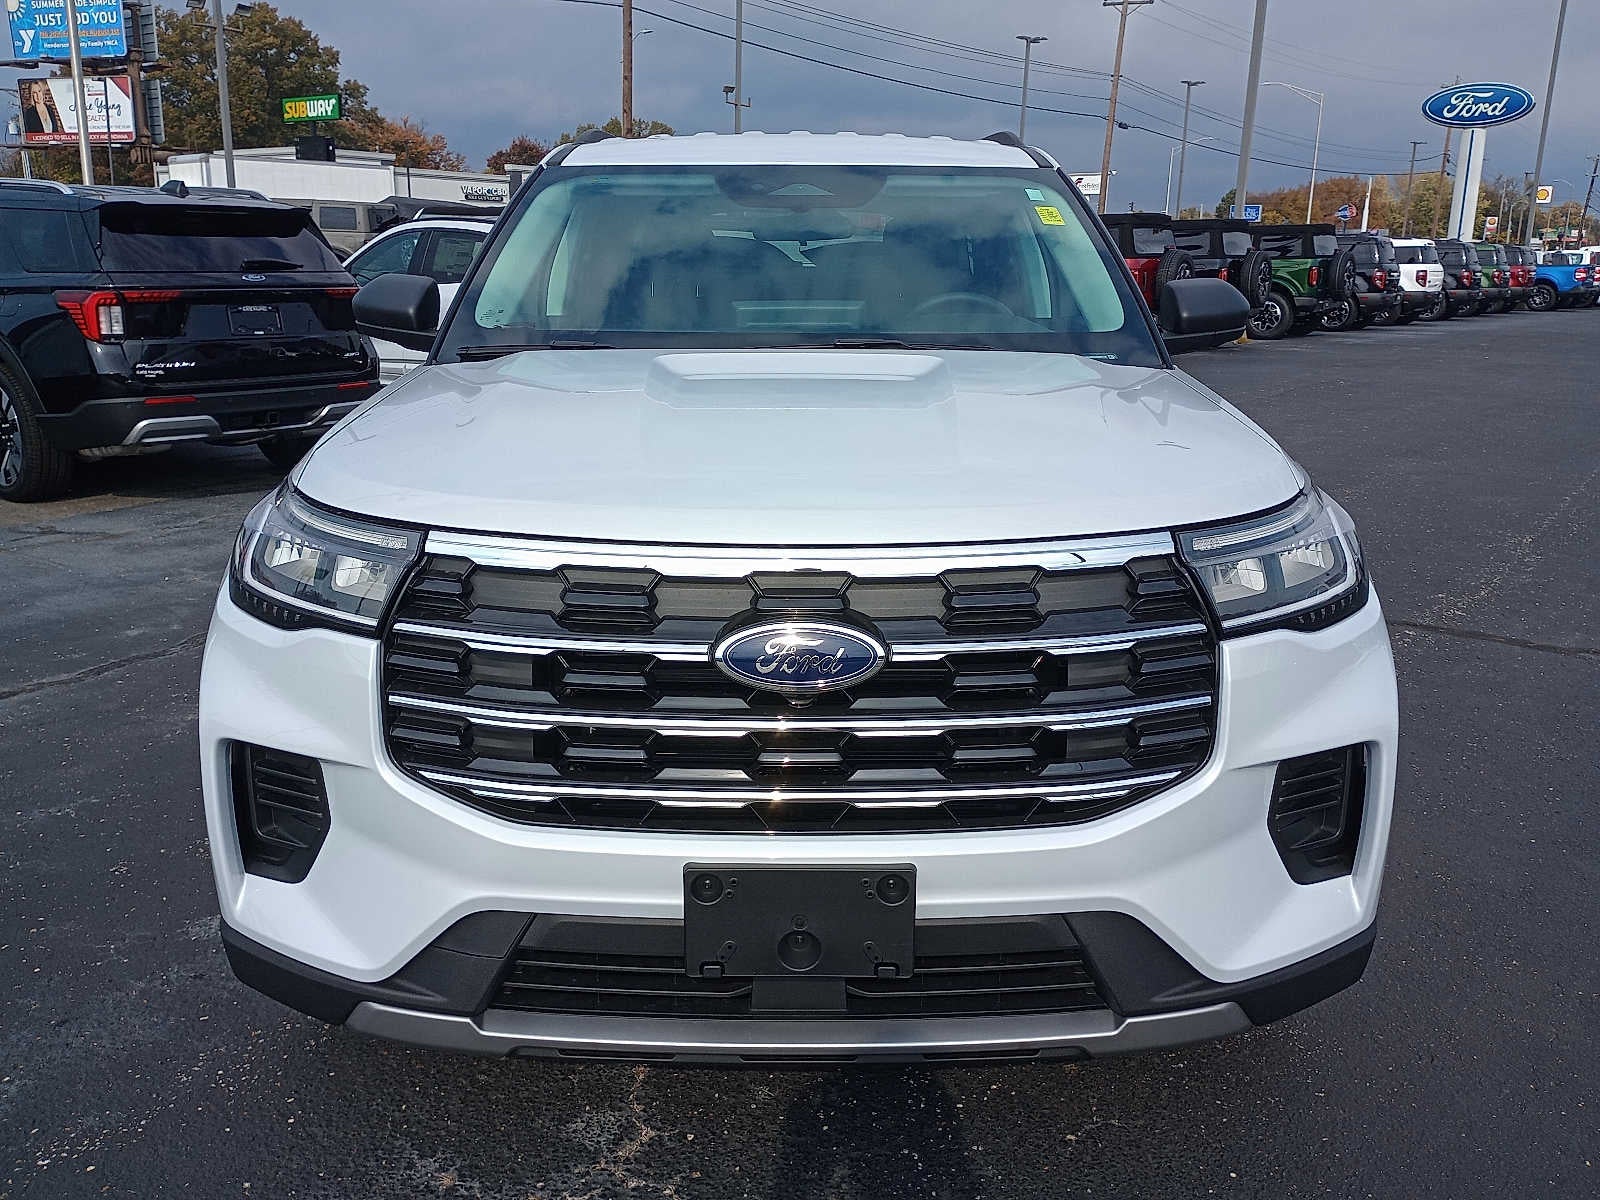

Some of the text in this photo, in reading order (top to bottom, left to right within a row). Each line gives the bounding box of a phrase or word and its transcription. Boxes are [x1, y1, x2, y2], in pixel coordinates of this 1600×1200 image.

[31, 0, 65, 9] SUMMER
[34, 13, 62, 26] JUST
[92, 11, 117, 24] YOU
[284, 98, 336, 119] SUBWAY
[1442, 91, 1510, 118] Ford
[460, 185, 488, 196] VAPOR
[755, 633, 845, 674] Ford
